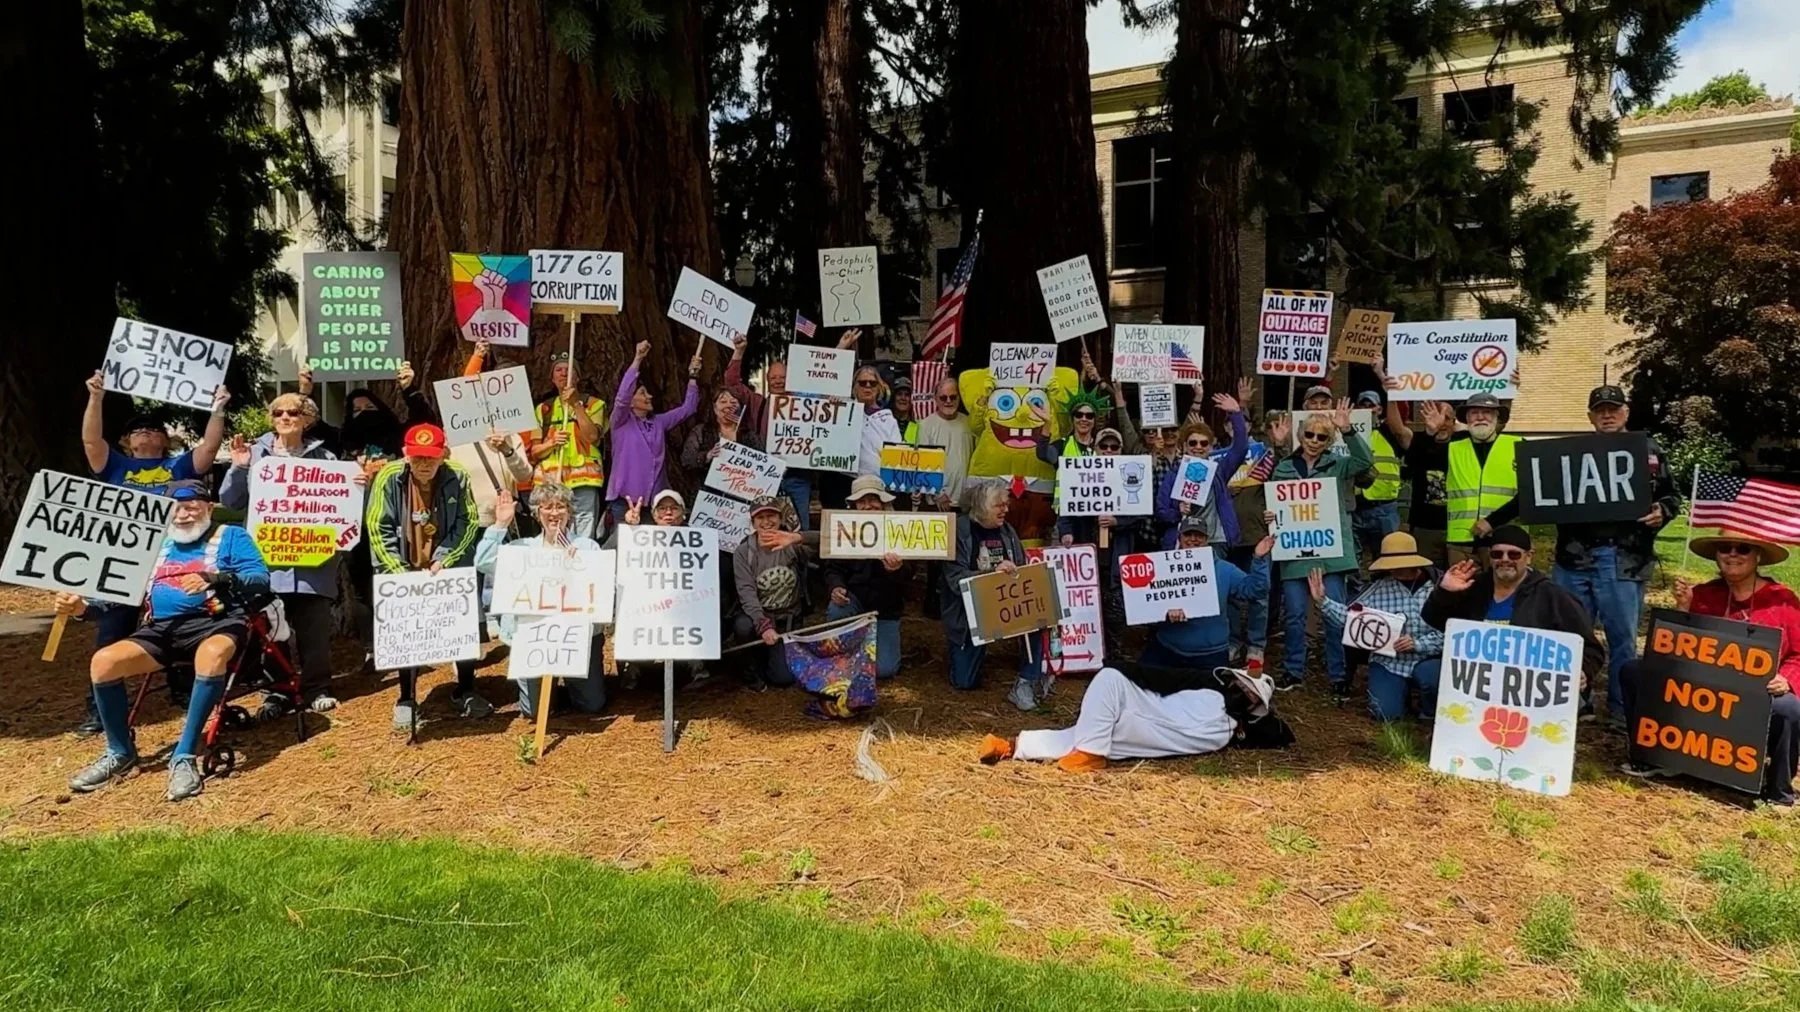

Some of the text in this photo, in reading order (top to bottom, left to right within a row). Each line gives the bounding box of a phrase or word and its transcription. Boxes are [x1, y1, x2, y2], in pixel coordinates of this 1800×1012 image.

[535, 253, 613, 276] 1776%
[823, 253, 873, 268] Pedophile
[312, 265, 385, 280] CARING
[320, 285, 381, 299] ABOUT
[530, 281, 618, 301] CORRUPTION
[1048, 284, 1097, 306] GOOD FOR
[320, 303, 382, 317] OTHER
[701, 289, 729, 313] END
[1049, 296, 1099, 318] ABSOLUTELY
[1267, 297, 1327, 313] ALL OF MY
[673, 299, 740, 342] CORRUPTIO
[1059, 311, 1099, 330] NOTHING
[1265, 314, 1326, 333] OUTRAGE
[1355, 323, 1379, 333] THE
[1361, 313, 1380, 324] DO
[318, 322, 392, 336] PEOPLE
[470, 321, 520, 339] RESIST
[1393, 331, 1508, 346] The Constitution
[111, 321, 230, 371] MONEY
[323, 339, 389, 354] IS NOT
[1263, 333, 1324, 348] CAN'T FIT ON
[808, 350, 837, 361] TRUMP
[991, 346, 1039, 361] CLEANUP
[1263, 345, 1321, 362] THIS SIGN
[1434, 348, 1468, 365] Says
[142, 352, 186, 376] THE
[1024, 361, 1048, 385] 47
[102, 359, 219, 409] FOLLOW
[806, 370, 839, 381] TRAITOR
[1397, 371, 1508, 395] NO Kings
[451, 373, 514, 400] STOP
[450, 406, 522, 431] Corruption
[721, 441, 770, 464] ALL ROADS
[770, 437, 815, 456] 1938
[728, 454, 753, 469] LEAD
[899, 451, 920, 468] NO
[1065, 458, 1115, 469] FLUSH
[259, 463, 347, 484] $1 Billion
[1078, 472, 1106, 484] THE
[1531, 450, 1635, 507] LIAR
[286, 484, 350, 498] BALLROOM
[1070, 486, 1113, 498] TURD
[1180, 489, 1199, 501] ICE
[1183, 481, 1201, 492] NO
[1276, 481, 1322, 502] STOP
[43, 471, 174, 526] VETERAN
[255, 497, 337, 515] $13 Million
[704, 494, 735, 510] HANDS
[323, 516, 349, 525] POOL
[1288, 503, 1320, 522] THE
[25, 502, 162, 552] AGAINST
[256, 525, 331, 545] $18 Billion
[837, 520, 878, 549] NO
[885, 518, 948, 551] WAR
[632, 530, 704, 548] GRAB
[1280, 528, 1335, 550] CHAOS
[15, 541, 140, 598] ICE
[626, 551, 710, 570] HIM BY
[1121, 550, 1194, 578] STOP ICE
[1169, 562, 1203, 573] FROM
[378, 576, 477, 599] CONGRESS
[643, 571, 694, 590] THE
[1150, 575, 1208, 590] KIDNAPPING
[512, 582, 595, 613] ALL!
[995, 579, 1034, 602] ICE
[378, 615, 457, 635] MUST LOWER
[526, 622, 585, 645] ICE
[1073, 622, 1097, 634] WILL
[1354, 614, 1386, 650] ICE
[633, 626, 704, 646] FILES
[521, 647, 580, 668] OUT
[1451, 627, 1572, 674] TOGETHER
[1653, 627, 1773, 676] BREAD
[1450, 658, 1571, 708] WE RISE
[1664, 678, 1740, 719] NOT
[1636, 716, 1758, 773] BOMBS
